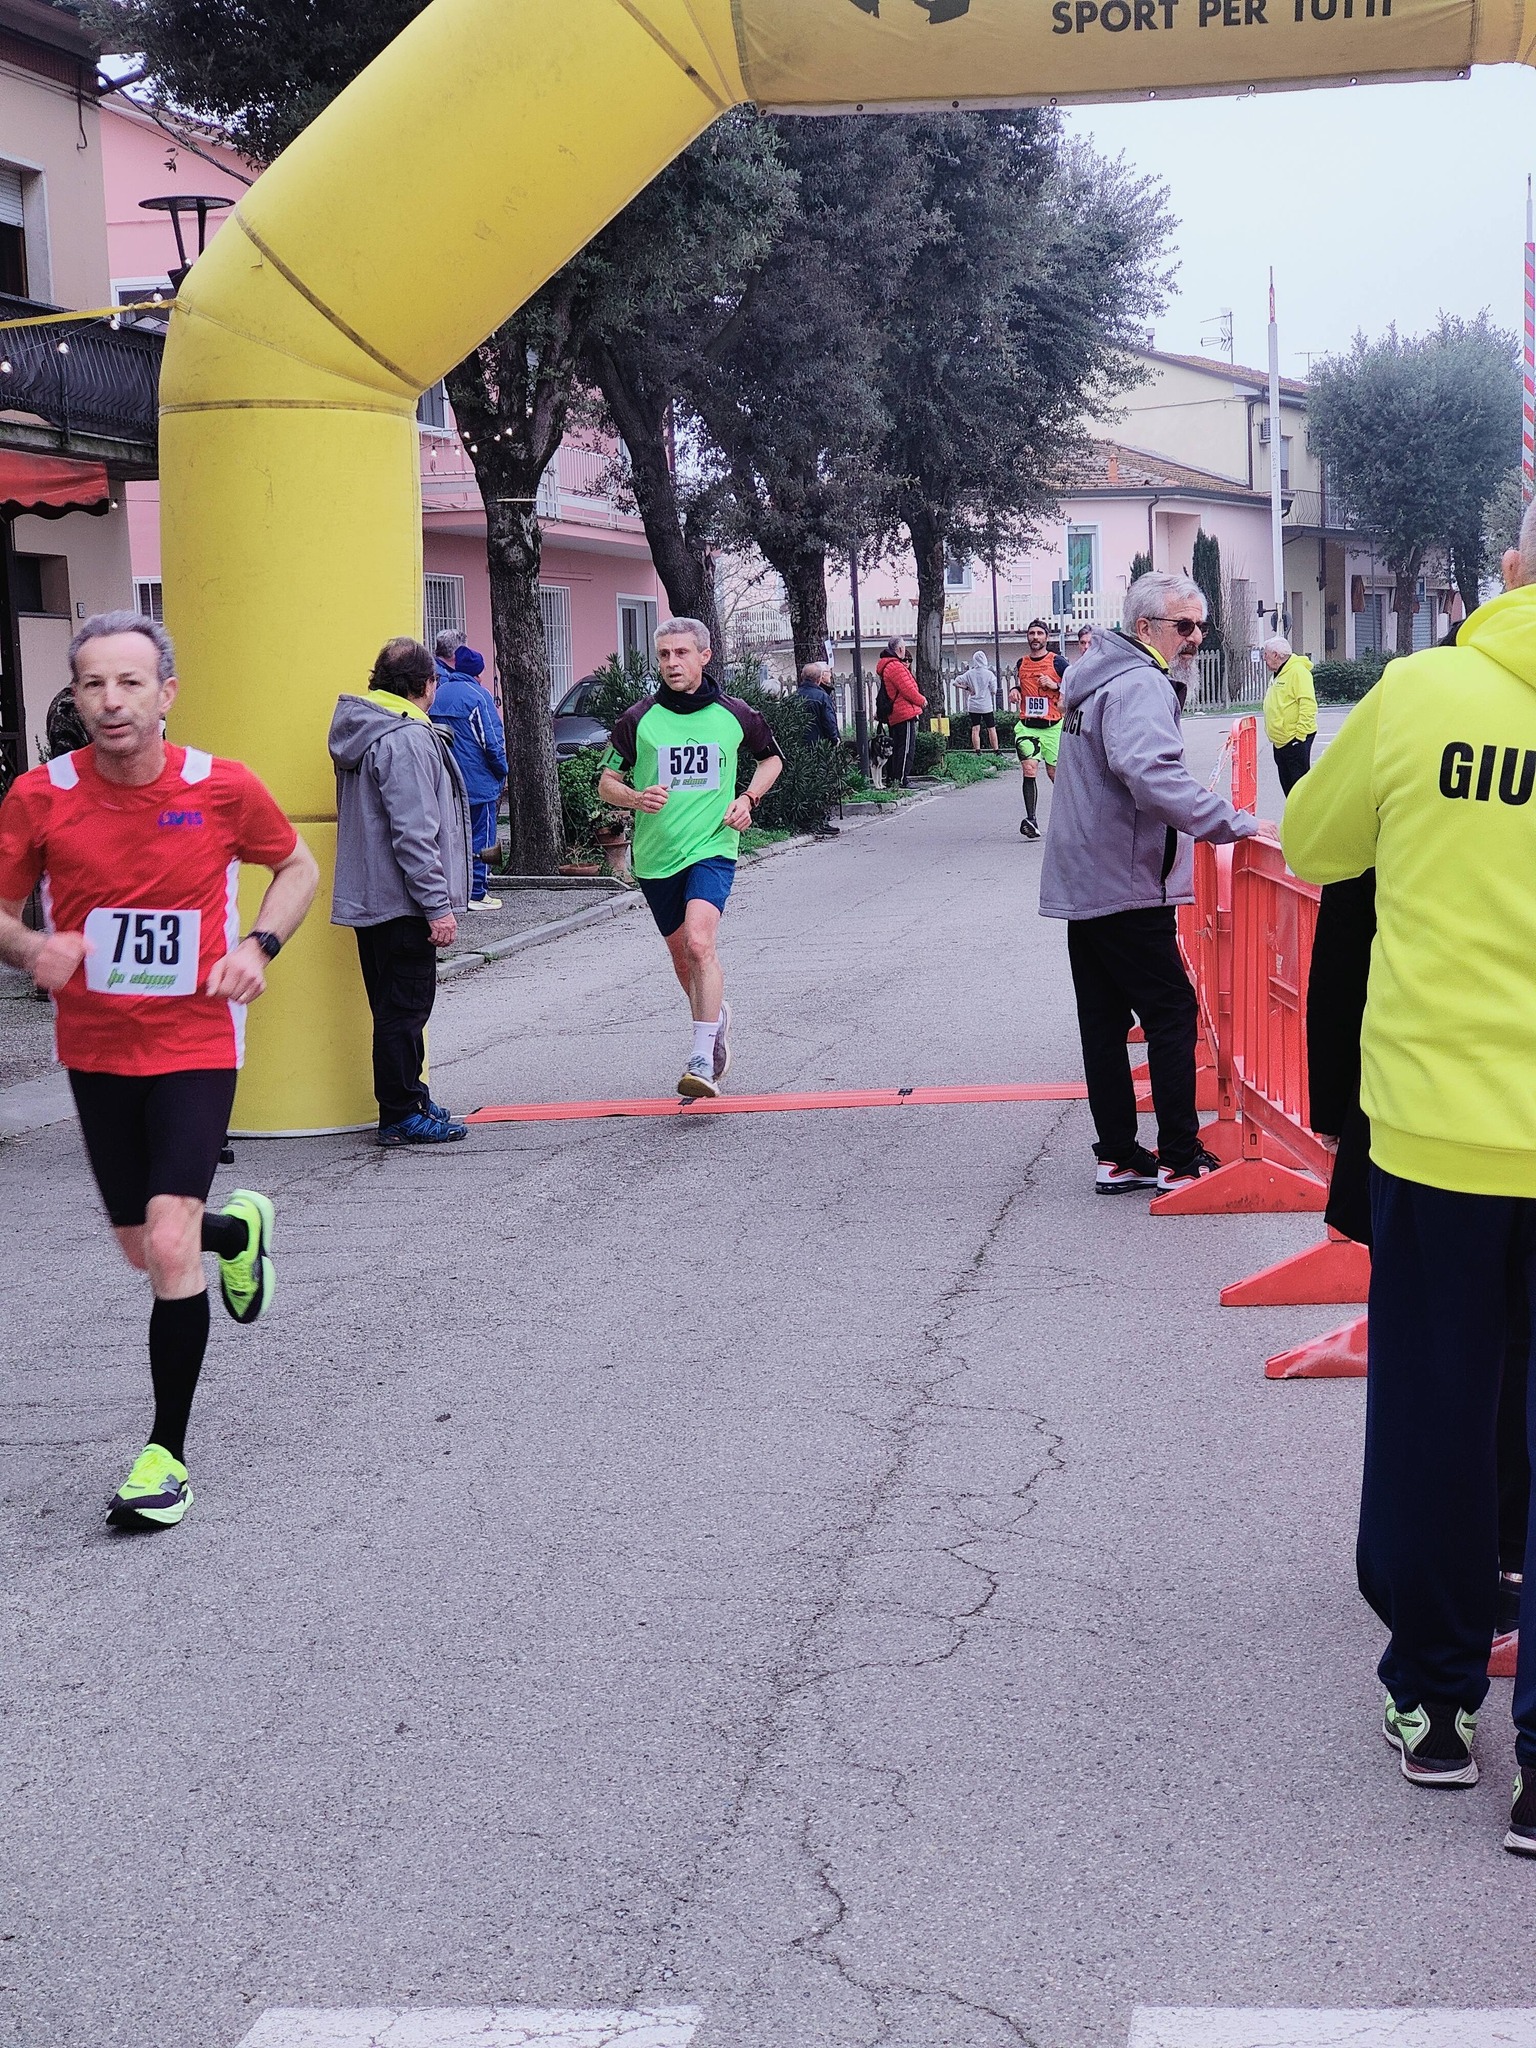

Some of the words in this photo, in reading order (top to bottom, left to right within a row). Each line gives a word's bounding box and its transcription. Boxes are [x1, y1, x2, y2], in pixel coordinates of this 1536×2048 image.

[1052, 0, 1179, 34] SPORT
[1199, 0, 1269, 27] PER
[1028, 697, 1044, 710] 669
[670, 745, 709, 775] 523
[1439, 741, 1536, 805] GIU
[112, 913, 180, 965] 753
